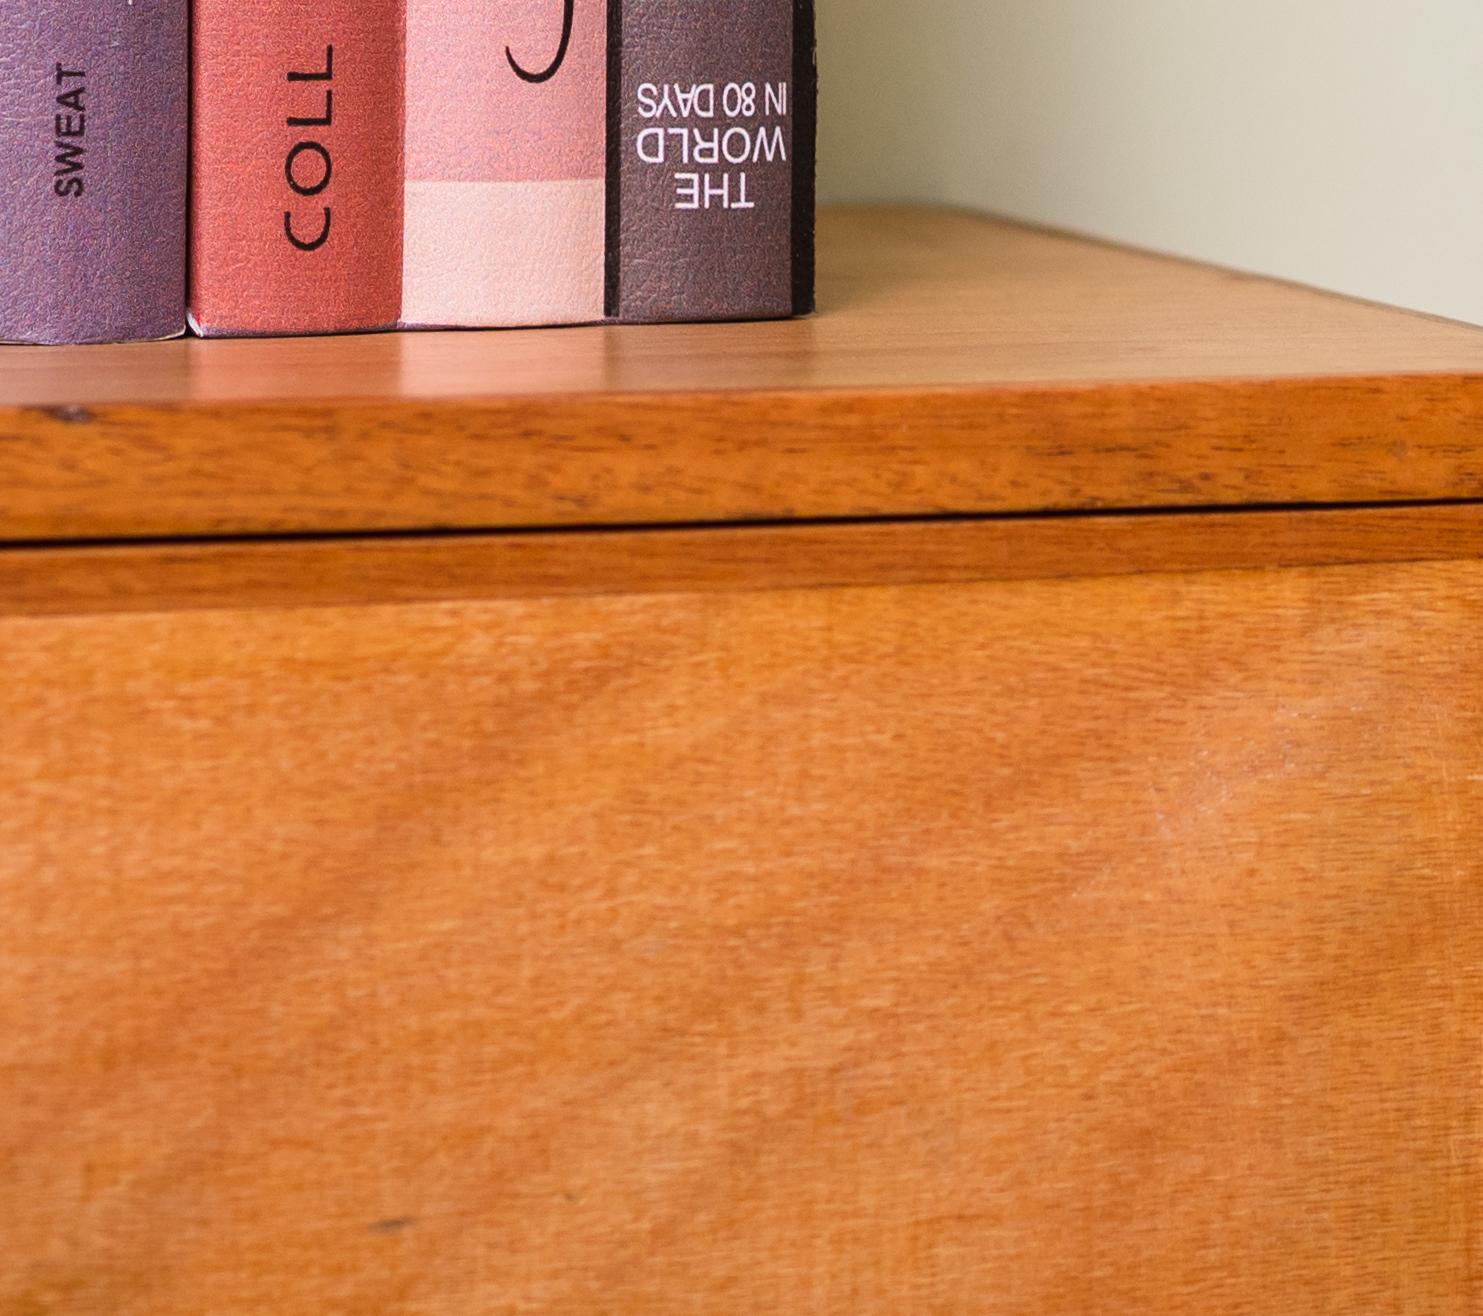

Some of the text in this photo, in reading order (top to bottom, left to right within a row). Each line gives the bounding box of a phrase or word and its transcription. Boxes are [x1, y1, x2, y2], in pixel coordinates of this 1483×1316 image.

[638, 82, 786, 117] IN 80 DAYS
[55, 63, 85, 197] SWEAT
[285, 45, 333, 251] COLL
[637, 127, 785, 163] WORLD
[675, 173, 754, 208] THE
